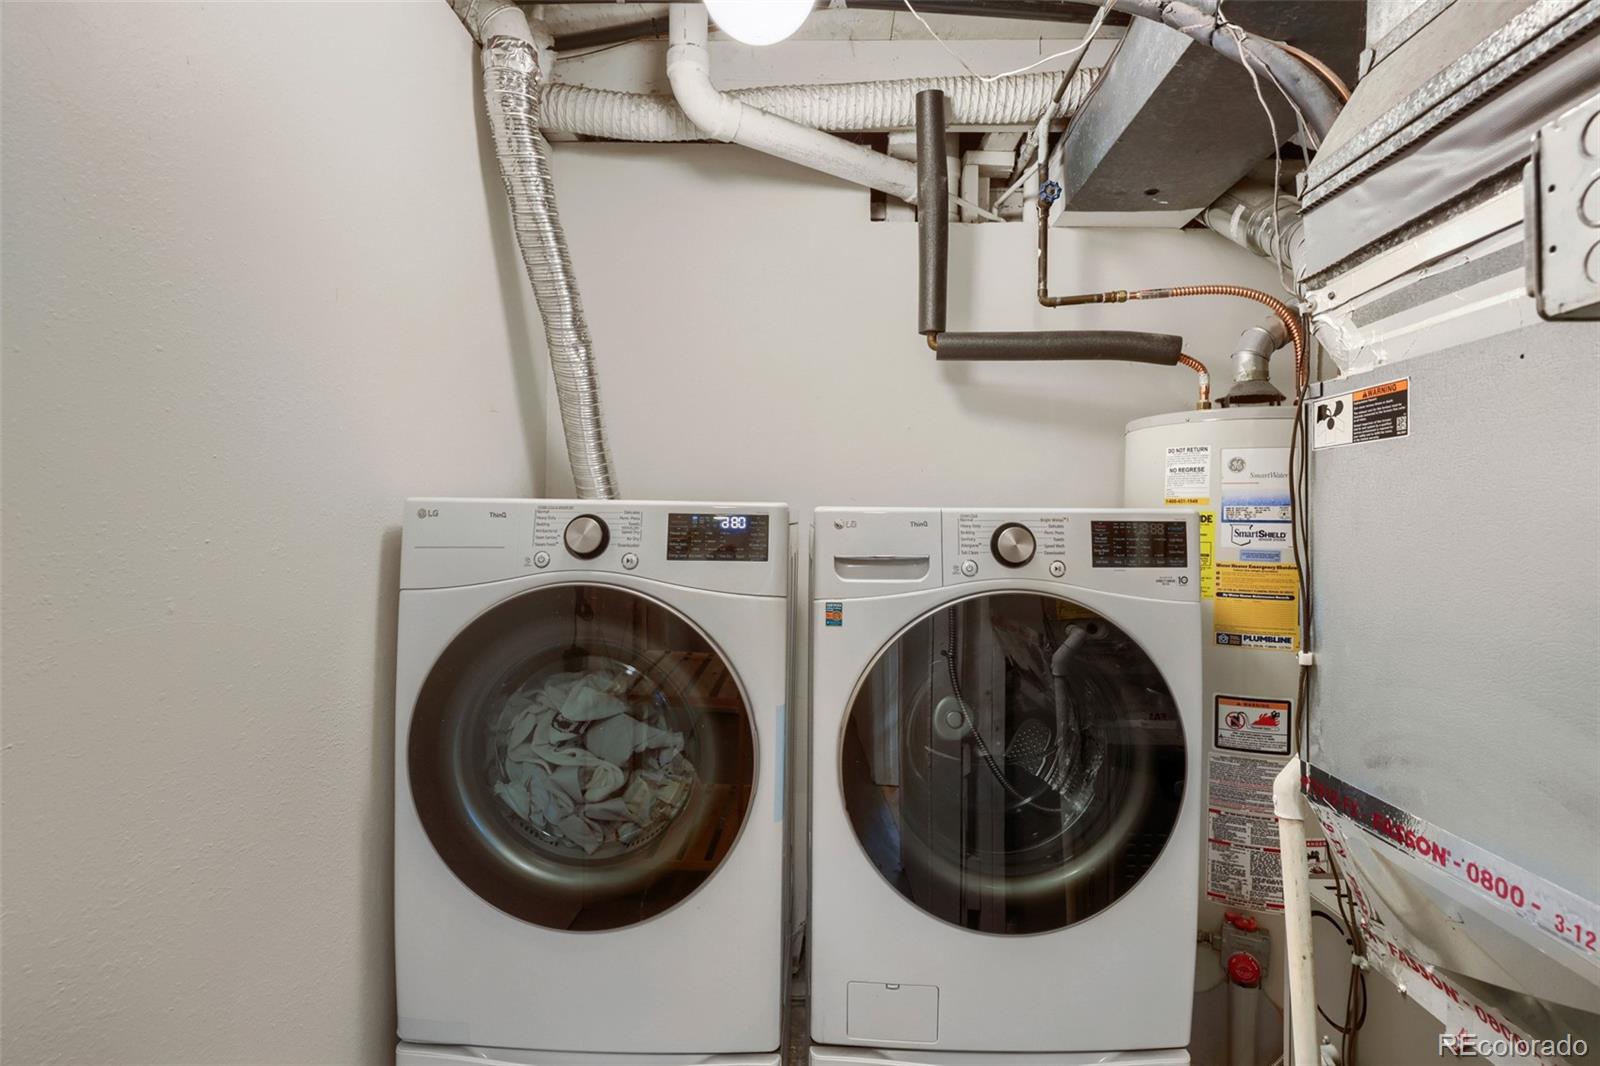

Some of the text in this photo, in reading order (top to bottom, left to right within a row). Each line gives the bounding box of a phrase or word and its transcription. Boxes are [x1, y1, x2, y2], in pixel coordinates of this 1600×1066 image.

[1367, 384, 1397, 396] WARNING
[427, 509, 439, 517] LG
[910, 520, 928, 528] ThinQ
[1243, 634, 1292, 644] PLUMBLINE
[1466, 862, 1525, 908] 0800
[1554, 913, 1597, 951] 3-12
